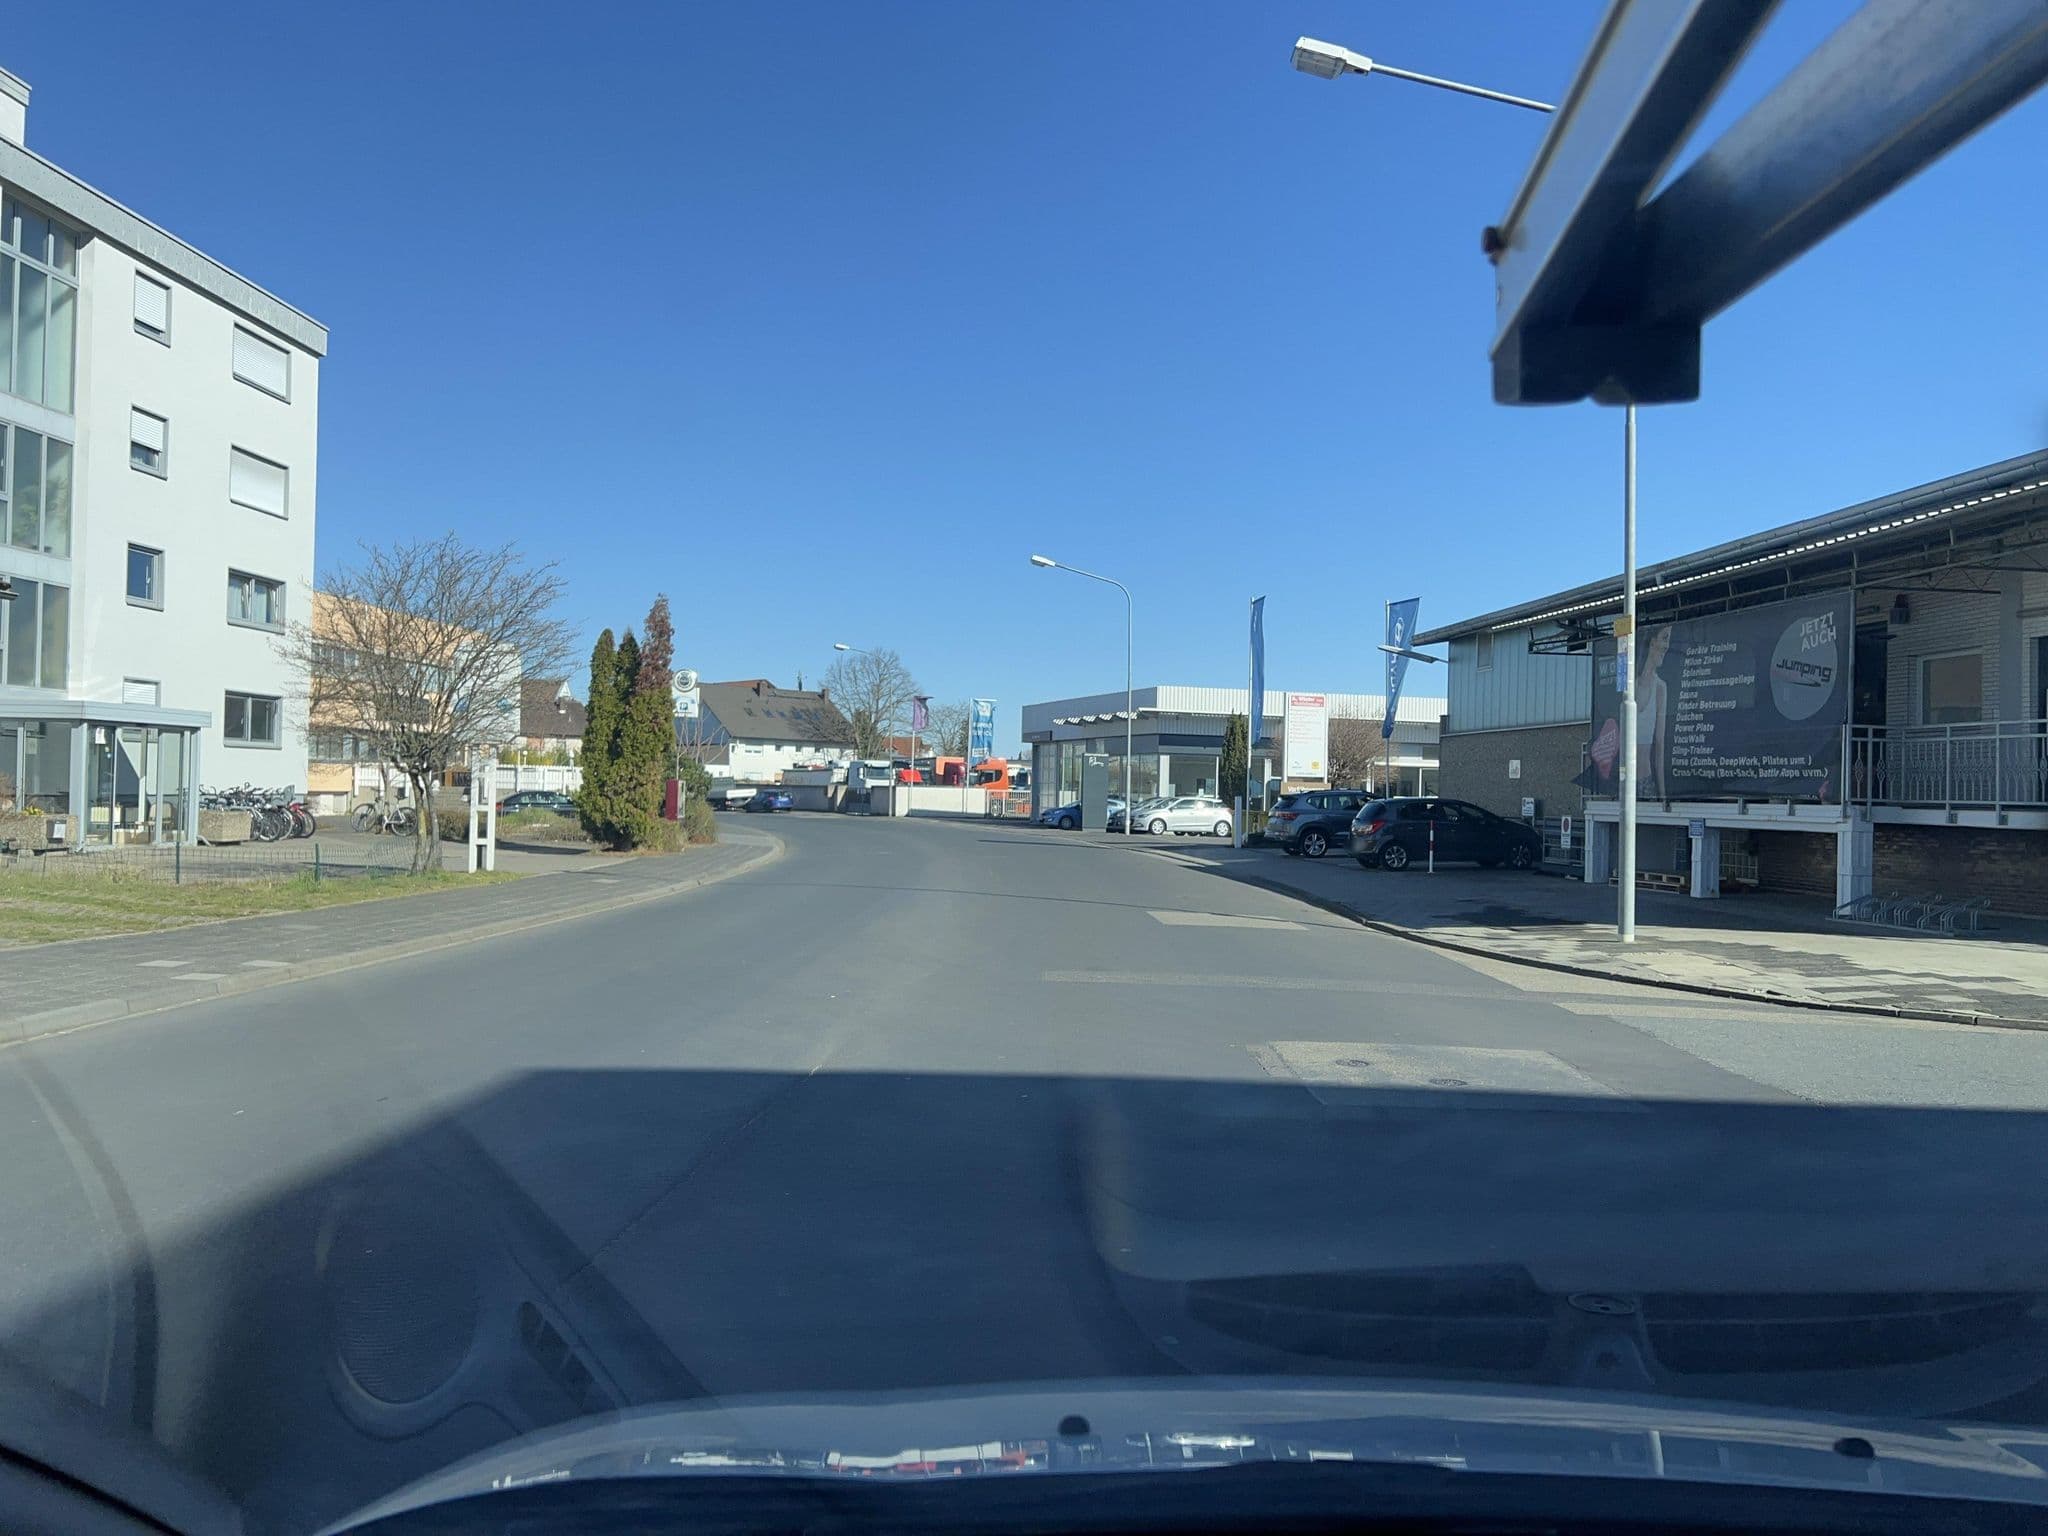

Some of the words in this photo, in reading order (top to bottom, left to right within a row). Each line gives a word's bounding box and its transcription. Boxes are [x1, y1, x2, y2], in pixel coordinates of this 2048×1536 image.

[1800, 611, 1834, 637] JETZT
[1801, 626, 1837, 653] AUCH
[1710, 642, 1737, 653] Training
[1776, 658, 1832, 683] Jumping
[1679, 690, 1698, 700] Sauna
[1677, 701, 1698, 711] Kinder
[1700, 699, 1737, 710] Betreuung
[1676, 712, 1704, 722] Duschen
[1674, 723, 1695, 733] Power
[1695, 723, 1715, 732] Plate
[1719, 756, 1761, 767] DeepWork,
[1762, 756, 1788, 765] Pilates
[1717, 768, 1758, 779] (Box-Sack,
